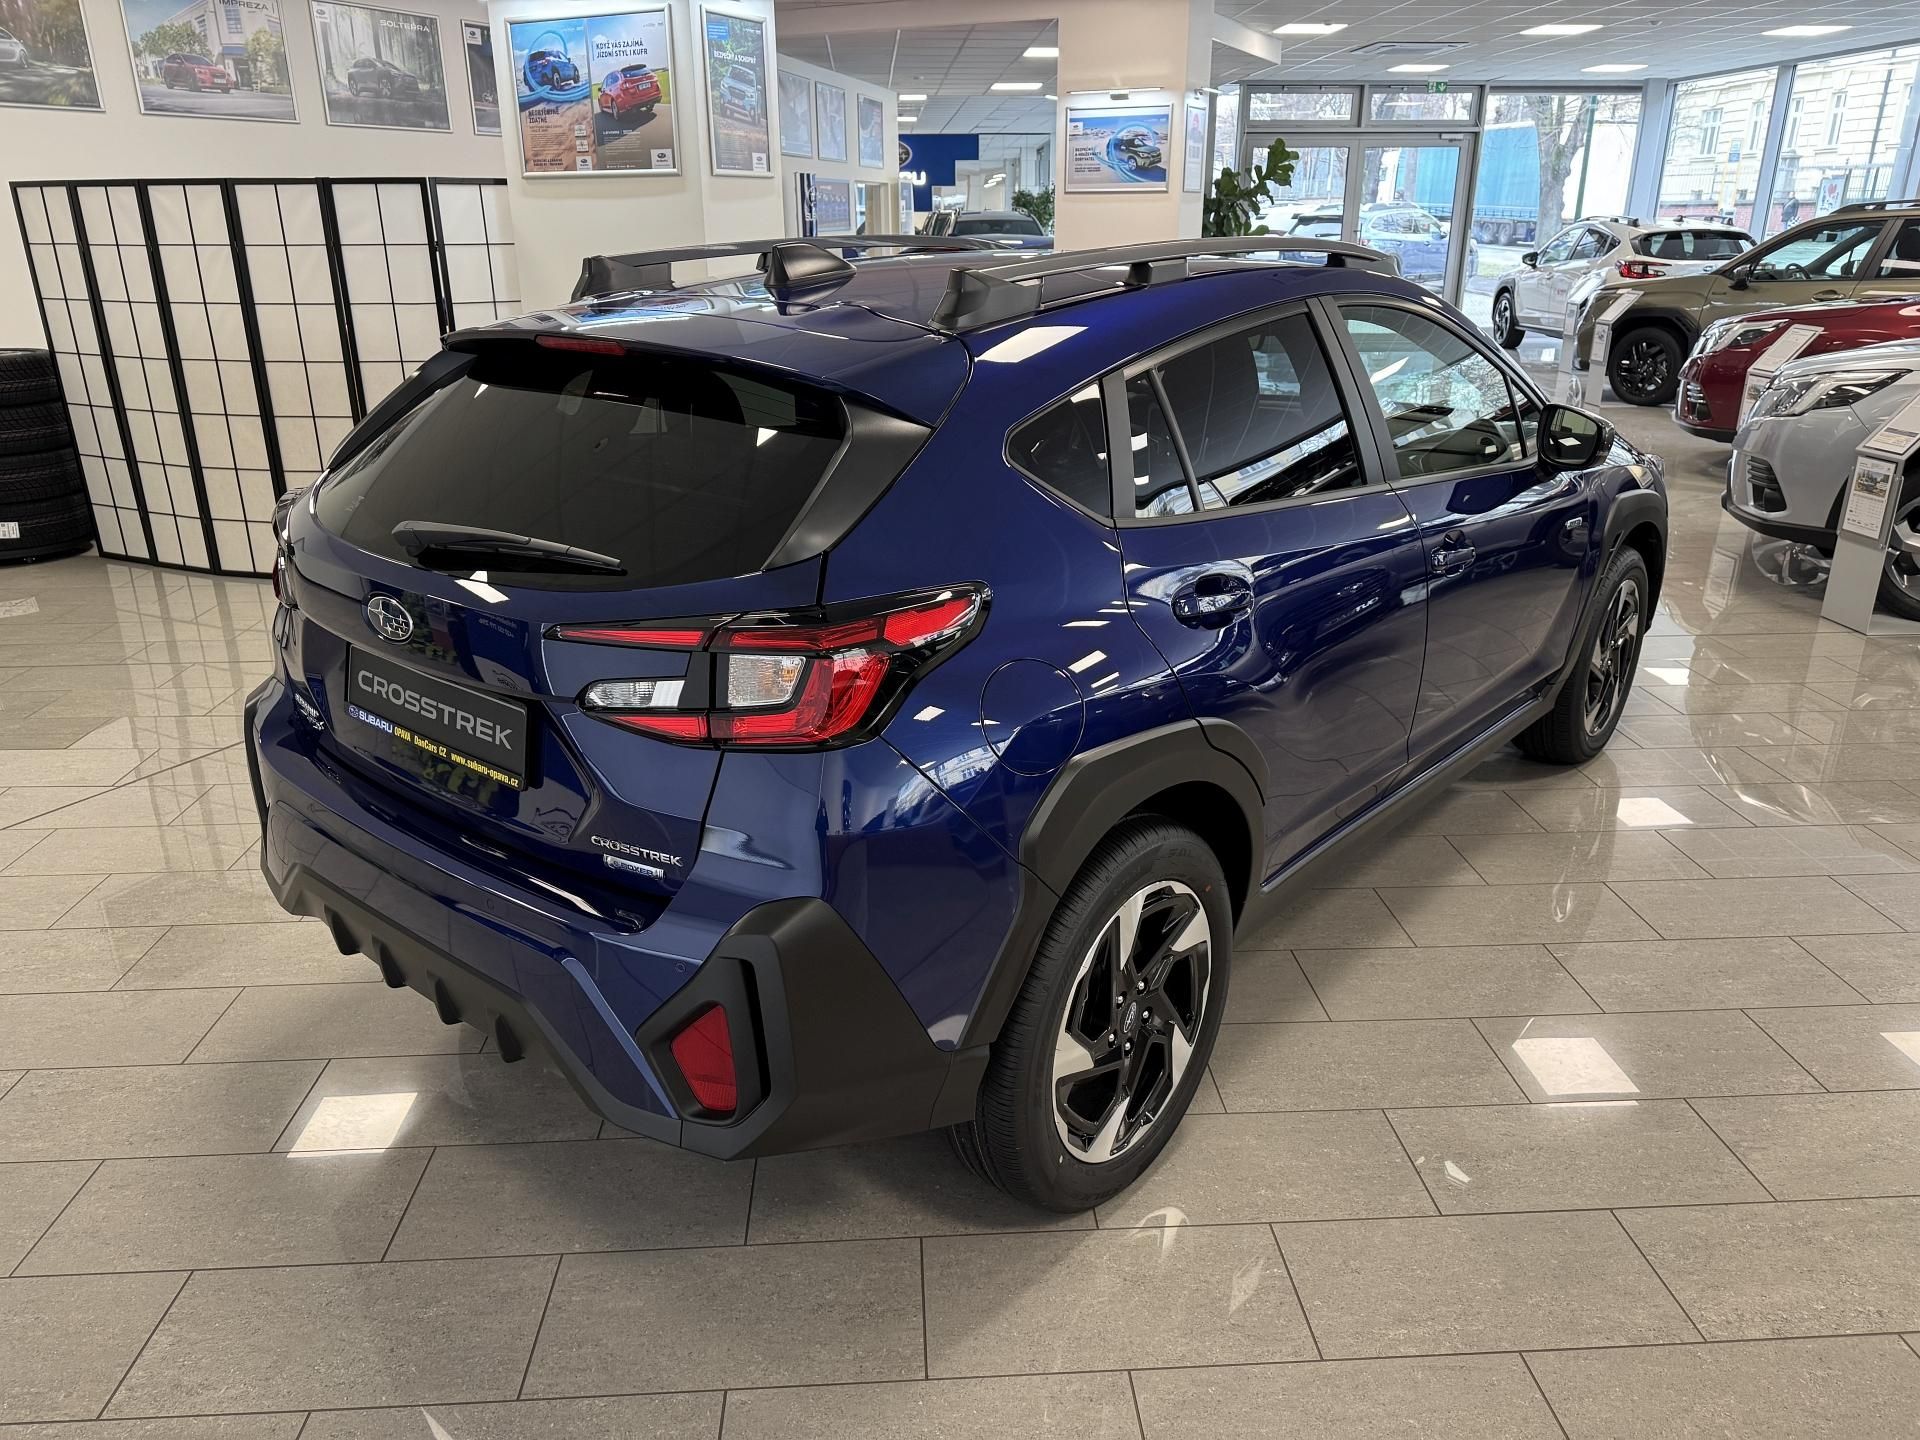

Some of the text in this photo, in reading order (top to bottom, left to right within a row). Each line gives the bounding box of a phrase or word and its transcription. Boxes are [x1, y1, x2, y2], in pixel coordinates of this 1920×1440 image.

[219, 0, 269, 10] IMPREZA
[379, 19, 430, 33] SOLTERRA
[596, 37, 643, 50] KDYŽ VÁS ZAJÍMÁ
[597, 49, 613, 58] JÍZDNÍ
[614, 49, 628, 57] STYL
[632, 48, 648, 56] KUFR
[357, 670, 513, 751] CROSSTREK
[358, 710, 519, 788] SUBARU OPAVA DanCars CZ www.subaru-opava.cz
[590, 835, 684, 867] CROSSTREK
